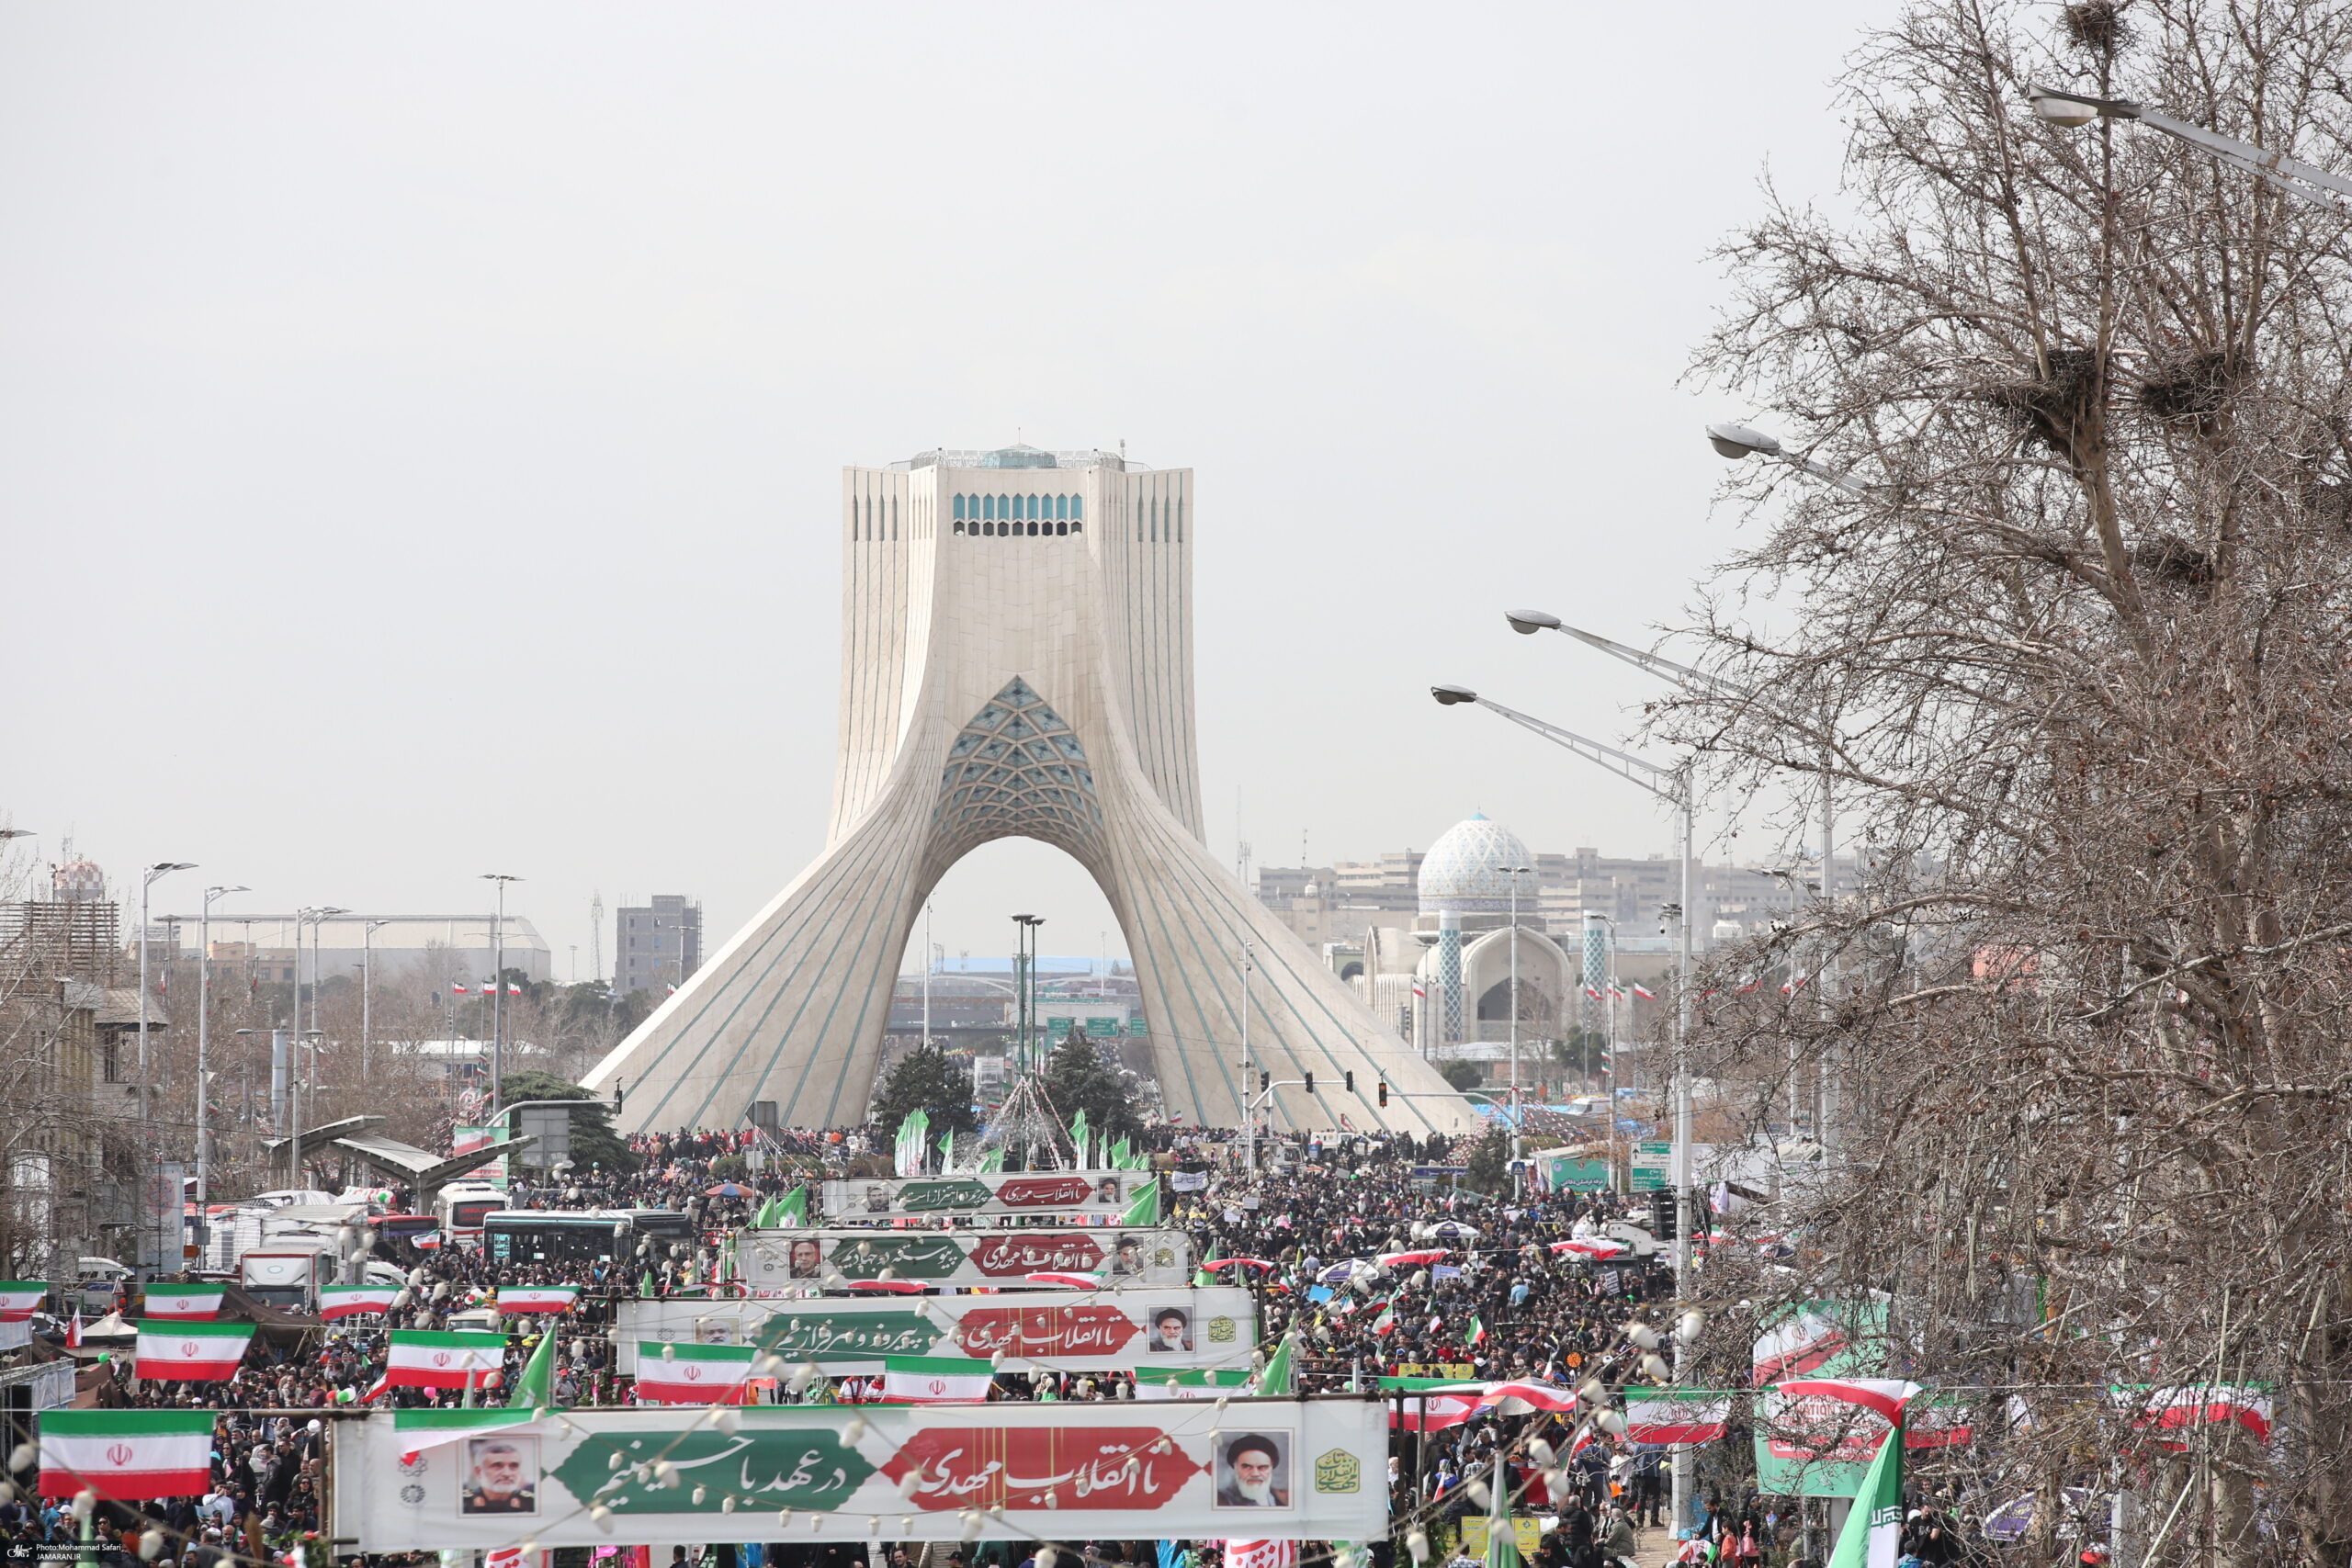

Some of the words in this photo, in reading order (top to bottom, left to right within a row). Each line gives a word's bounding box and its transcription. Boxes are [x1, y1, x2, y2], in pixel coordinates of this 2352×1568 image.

[967, 1189, 988, 1205] پرچم
[1005, 1186, 1033, 1202] مهدی
[1033, 1182, 1074, 1204] انقلاب
[1075, 1182, 1085, 1200] تا
[982, 1246, 1021, 1270] مهدی
[854, 1333, 866, 1348] و
[1021, 1315, 1102, 1353] انقلاب
[1104, 1314, 1123, 1347] تا
[740, 1455, 757, 1506] با
[755, 1449, 824, 1494] عهد
[812, 1467, 847, 1495] در
[917, 1448, 1003, 1497] مهدی
[1005, 1444, 1137, 1505] انقلاب
[1143, 1445, 1168, 1495] تا
